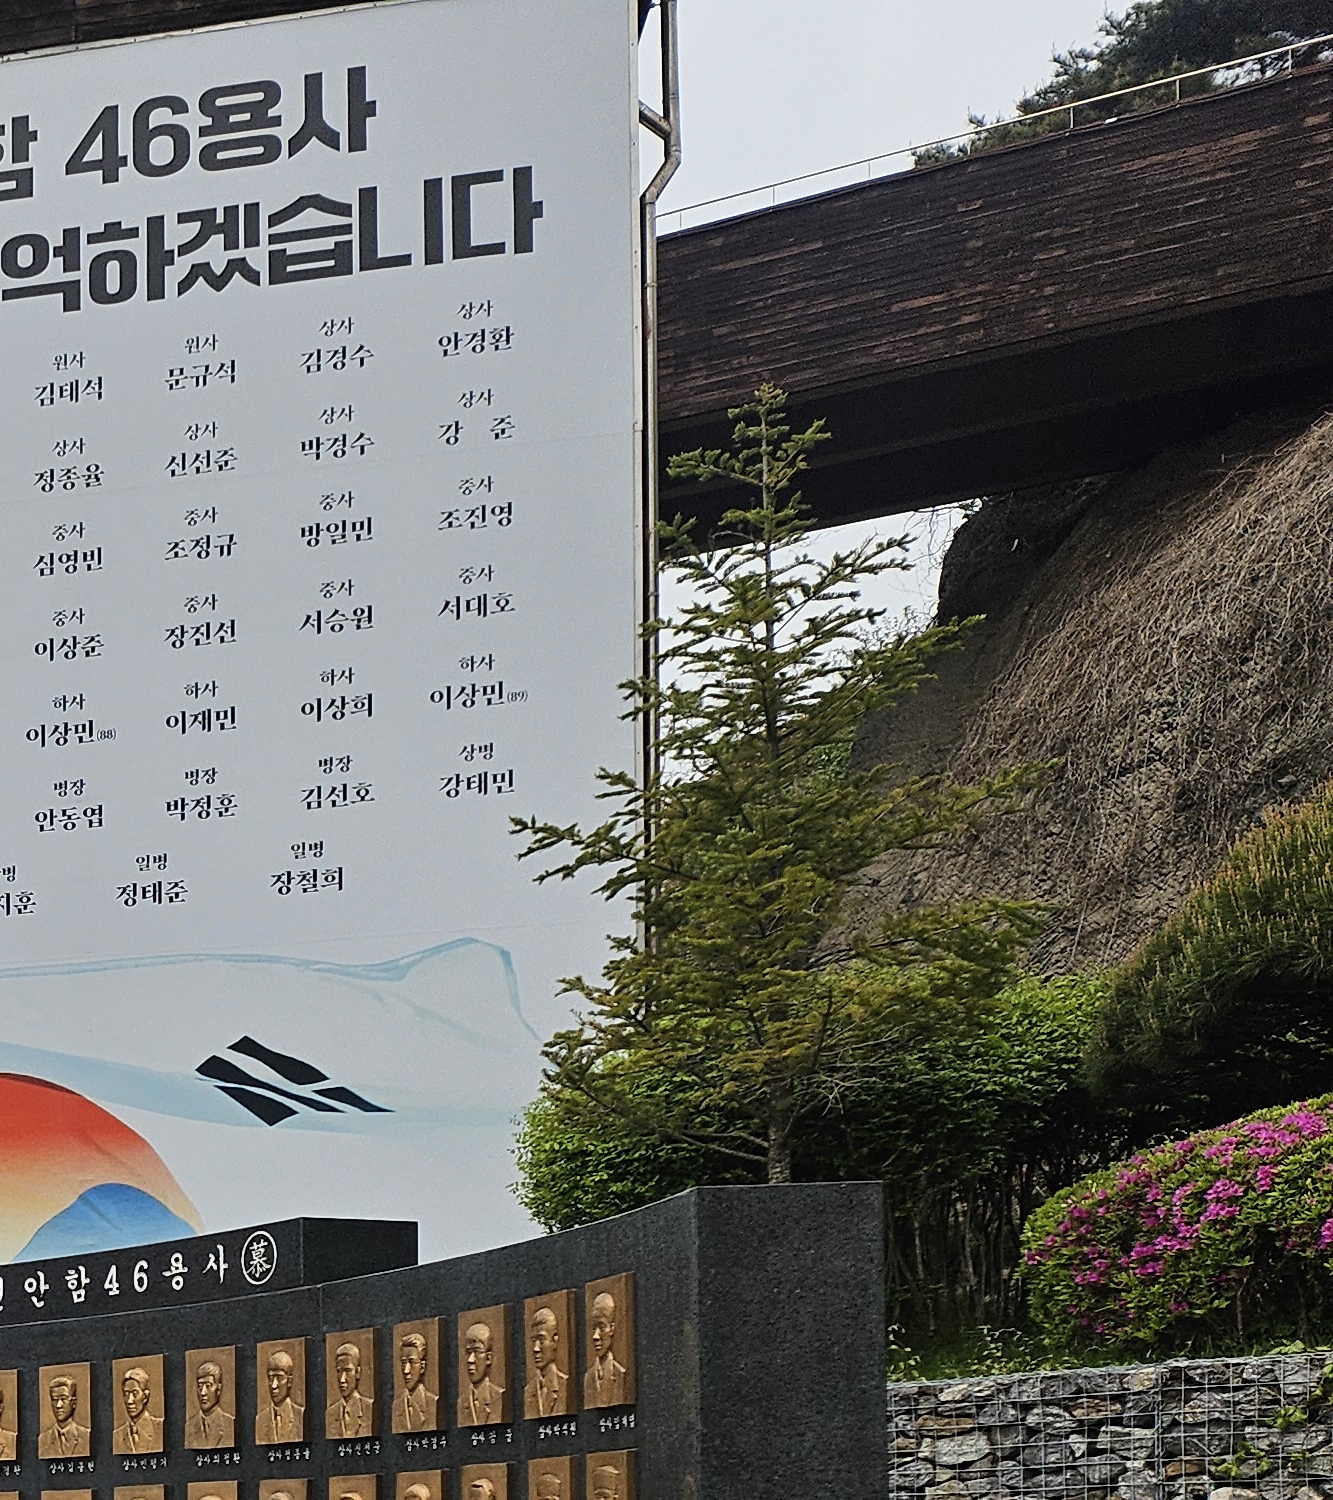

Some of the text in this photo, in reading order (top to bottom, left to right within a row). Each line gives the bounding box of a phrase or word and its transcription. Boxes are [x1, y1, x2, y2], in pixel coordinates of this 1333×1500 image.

[65, 65, 377, 185] 46용사
[456, 299, 494, 321] 상사
[318, 316, 355, 338] 상사
[184, 333, 219, 355] 원사
[437, 325, 516, 358] 안경환
[52, 350, 87, 372] 원사
[299, 343, 375, 375] 김경수
[164, 359, 236, 391] 문규석
[33, 375, 103, 408] 김태석
[457, 387, 495, 409] 상사
[318, 404, 355, 425] 상사
[183, 420, 219, 442] 상사
[51, 437, 87, 458] 상사
[300, 431, 376, 461] 박경수
[164, 446, 239, 478] 신선준
[33, 463, 105, 494] 정종율
[458, 475, 495, 496] 중사
[319, 490, 355, 512] 중사
[183, 506, 219, 527] 중사
[437, 501, 513, 531] 조진영
[51, 521, 86, 542] 중사
[300, 516, 374, 548] 방일민
[164, 533, 238, 561] 조정규
[32, 546, 104, 578] 심영빈
[458, 564, 495, 585] 중사
[319, 578, 355, 600] 중사
[183, 593, 219, 614] 중사
[437, 591, 516, 621] 서대호
[51, 607, 86, 628] 중사
[298, 604, 374, 635] 서승원
[163, 618, 237, 650] 장진선
[34, 633, 105, 663] 이상준
[458, 653, 496, 673] 하사
[319, 666, 356, 687] 하사
[183, 679, 219, 700] 하사
[51, 692, 87, 713] 하사
[300, 692, 373, 723] 이상희
[165, 705, 237, 736] 이재민
[458, 741, 494, 763] 상병
[318, 754, 354, 775] 병장
[184, 766, 219, 787] 병장
[438, 768, 515, 799] 강태민
[53, 778, 87, 798] 병장
[300, 781, 376, 811] 김선호
[34, 803, 104, 833] 안동엽
[164, 793, 239, 822] 박정훈
[290, 840, 324, 860] 일병
[135, 852, 168, 872] 일병
[269, 866, 344, 896] 장철희
[115, 879, 189, 908] 정태준
